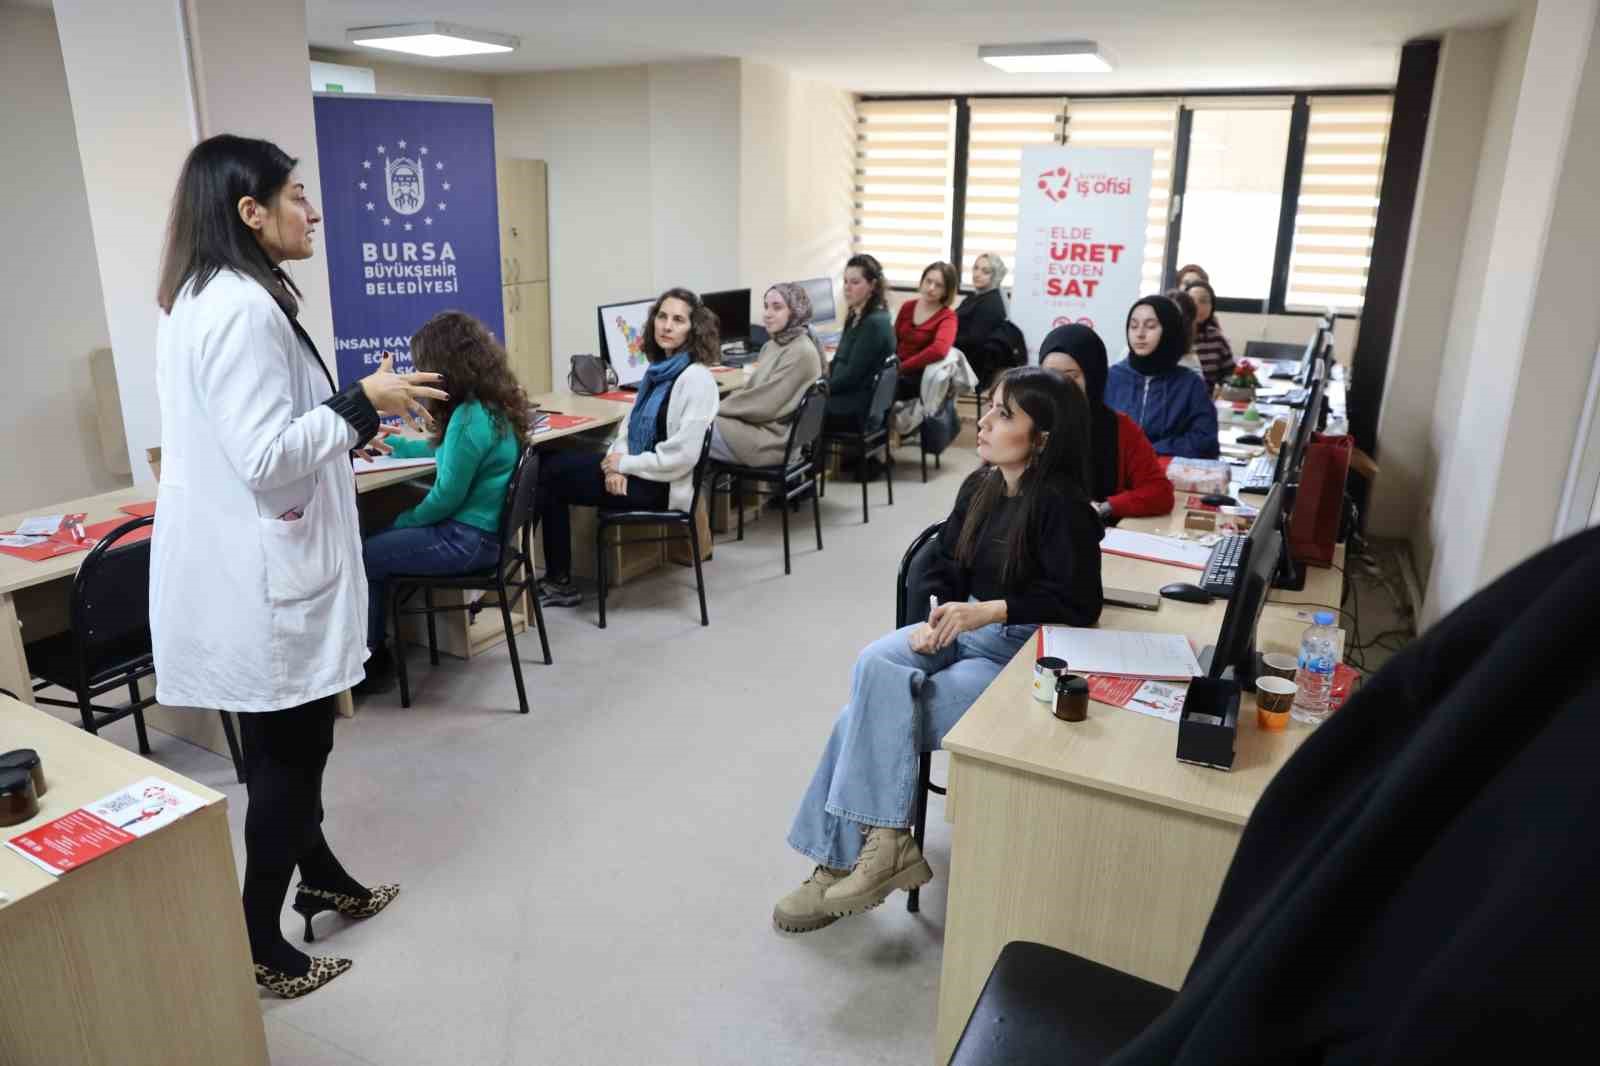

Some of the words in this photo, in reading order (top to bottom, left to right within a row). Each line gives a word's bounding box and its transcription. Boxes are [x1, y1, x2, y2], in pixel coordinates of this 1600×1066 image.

[1094, 177, 1132, 194] ofisi
[1051, 226, 1093, 240] ELDE
[362, 241, 456, 262] BURSA
[1050, 242, 1125, 263] ÜRET
[364, 260, 457, 278] BÜYÜKŞEHİR
[1048, 262, 1104, 277] EVDEN
[366, 275, 458, 295] BELEDİYESİ
[1047, 278, 1099, 298] SAT
[335, 336, 380, 351] İNSAN
[384, 335, 412, 348] KAY
[364, 349, 412, 364] EĞİM
